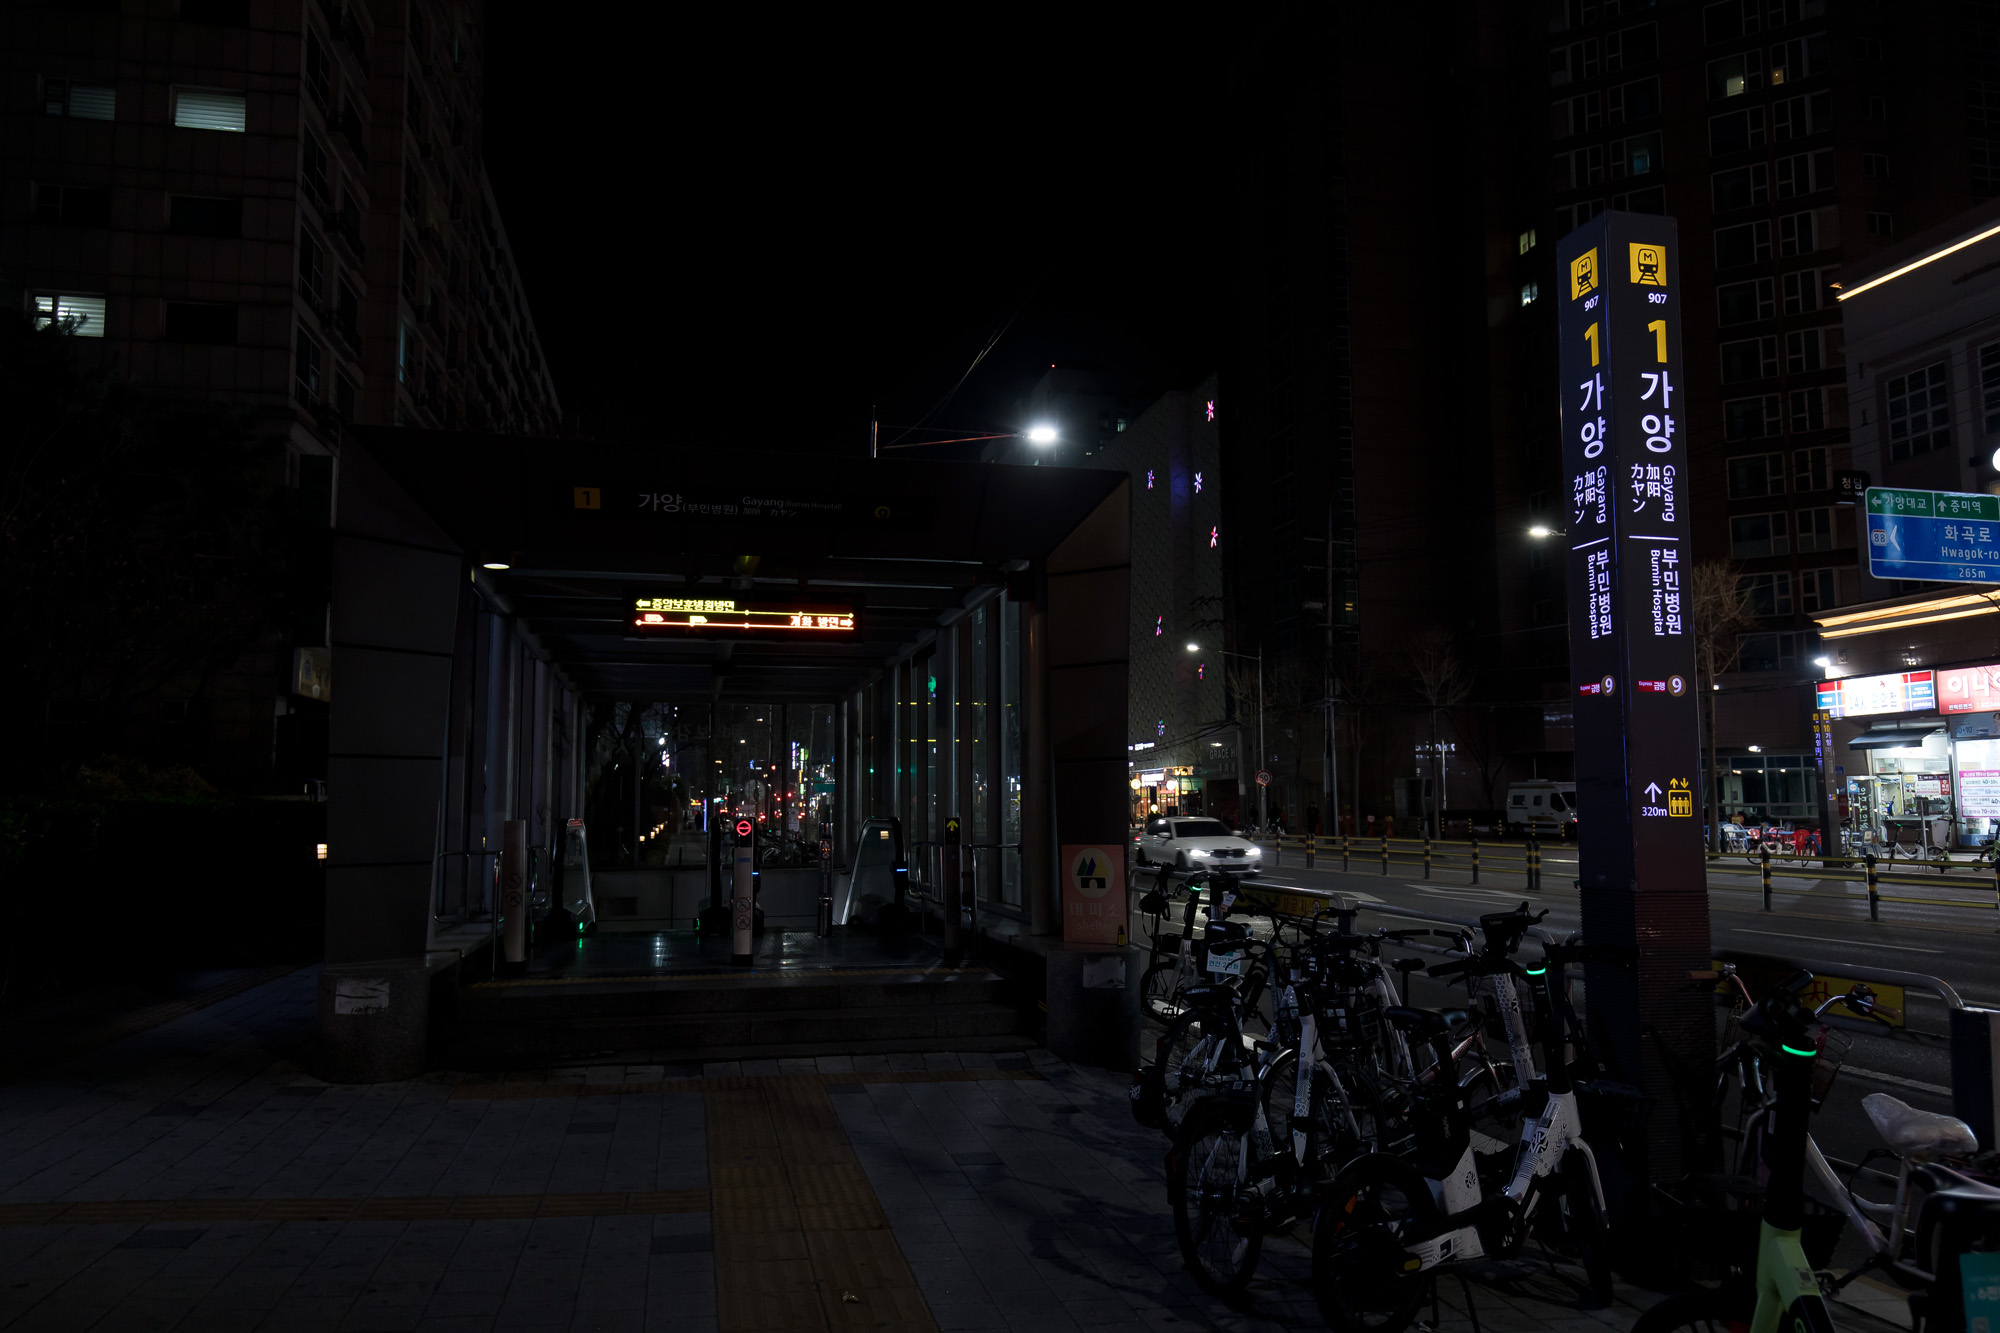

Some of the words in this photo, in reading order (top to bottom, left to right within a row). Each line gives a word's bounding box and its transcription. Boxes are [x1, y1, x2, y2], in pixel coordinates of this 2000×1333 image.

[1584, 294, 1599, 312] 907
[1648, 292, 1667, 305] 907
[1584, 321, 1600, 368] 1
[1647, 319, 1668, 364] 1
[1579, 372, 1606, 459] 가양
[1640, 370, 1675, 453] 가양
[1630, 462, 1646, 513] カヤン
[1645, 462, 1661, 498] 加阳
[581, 491, 590, 506] 1
[637, 491, 684, 513] 가양
[682, 501, 739, 517] (부민병원)
[742, 495, 784, 509] Gayang
[1573, 474, 1585, 525] カヤン
[1595, 465, 1607, 524] Gayang
[1661, 464, 1676, 523] Gayang
[1885, 496, 1927, 511] 가양대교
[1950, 499, 1981, 514] 증미역
[1873, 533, 1886, 543] 88
[1944, 524, 1992, 545] 화곡로
[1941, 546, 1999, 561] Hwagok-ro
[1587, 554, 1597, 591] Bumin
[1650, 549, 1662, 586] Bumin
[1958, 567, 1986, 579] 265m
[1596, 549, 1612, 636] 부민병원
[1661, 548, 1682, 635] 부민병원
[817, 616, 839, 628] 방면
[1589, 592, 1599, 639] Hospital
[1652, 589, 1665, 636] Hospital
[1605, 677, 1613, 694] 9
[1671, 677, 1682, 694] 9
[1823, 724, 1831, 733] 10
[1259, 774, 1269, 783] 50
[1641, 806, 1668, 817] 320m
[1069, 901, 1121, 918] 대피소
